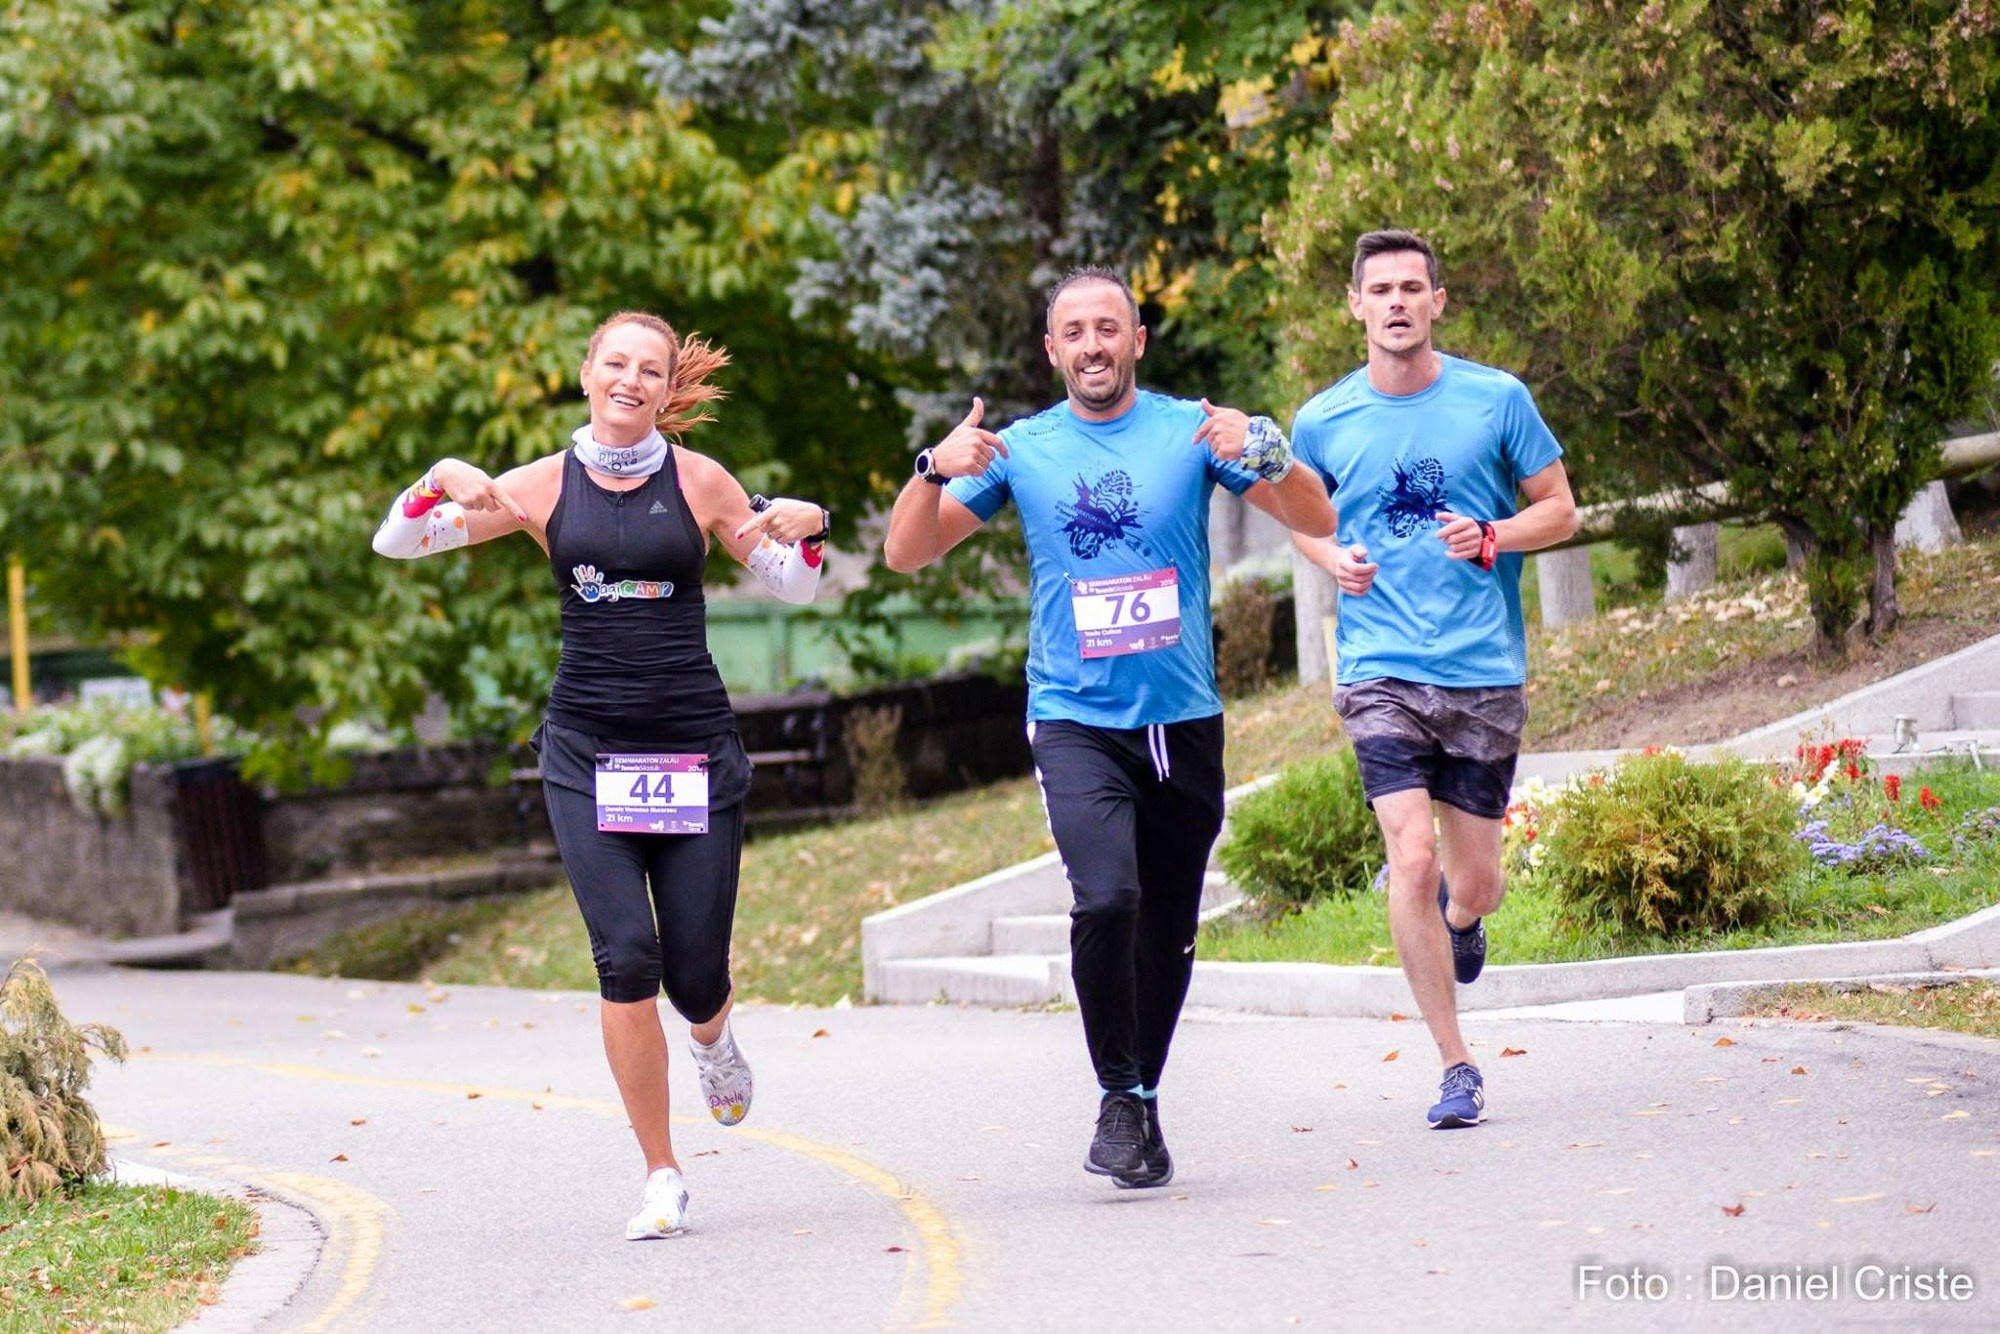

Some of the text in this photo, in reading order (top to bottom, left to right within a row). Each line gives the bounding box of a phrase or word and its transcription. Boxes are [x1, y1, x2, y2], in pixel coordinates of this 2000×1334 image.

[1105, 592, 1151, 625] 76
[1086, 638, 1112, 648] 21 km
[629, 774, 675, 804] 44
[606, 814, 633, 823] 21 km
